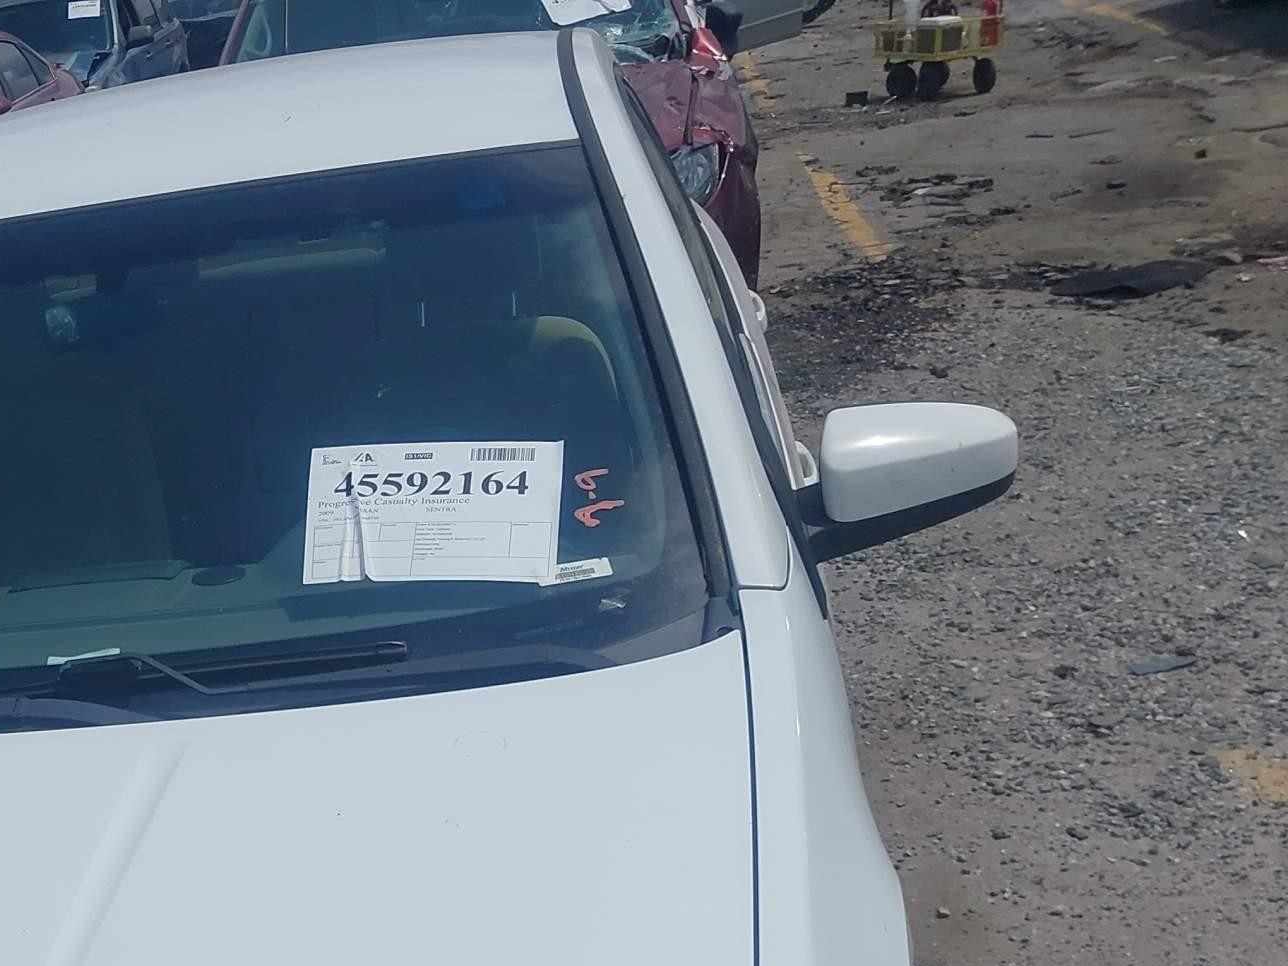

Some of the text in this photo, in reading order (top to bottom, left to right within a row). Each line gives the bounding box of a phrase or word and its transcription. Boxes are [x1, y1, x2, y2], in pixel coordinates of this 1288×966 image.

[333, 471, 529, 498] 45592164
[318, 496, 471, 510] Progreve Casualty Insurance
